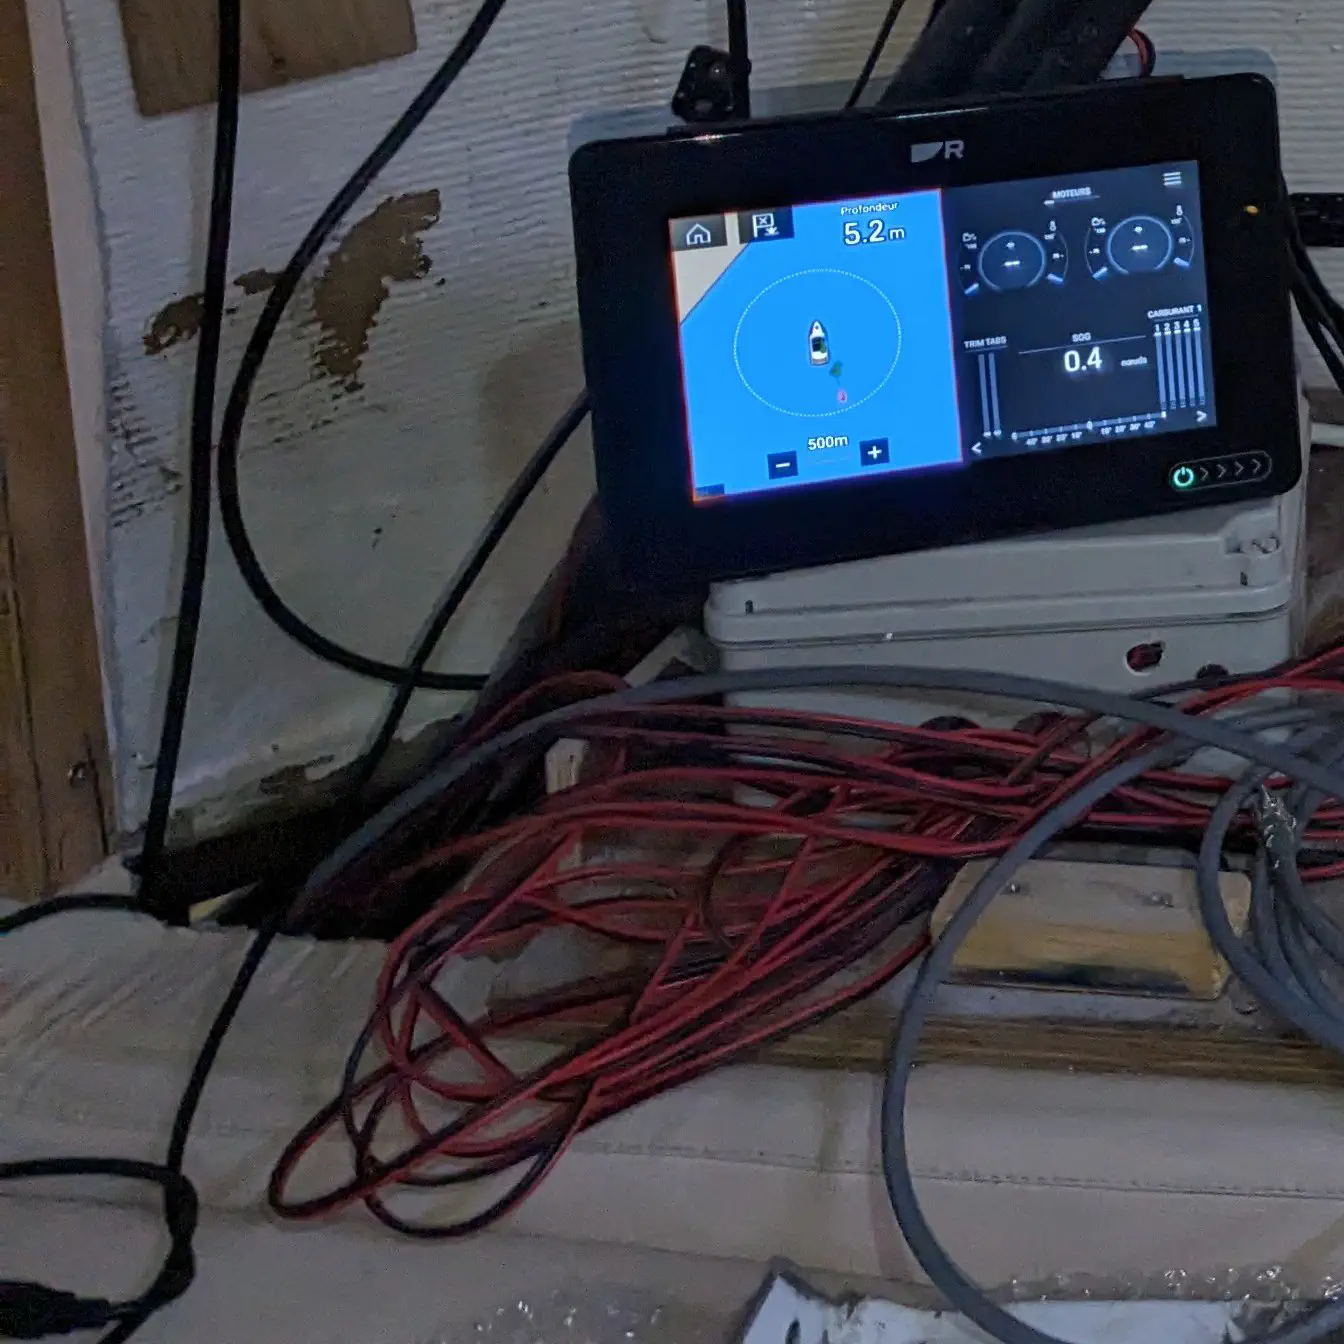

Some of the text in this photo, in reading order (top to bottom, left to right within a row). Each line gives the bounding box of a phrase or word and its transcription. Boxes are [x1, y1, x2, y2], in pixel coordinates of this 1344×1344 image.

[1052, 187, 1092, 199] MOTEURS
[840, 202, 899, 216] Profondeur
[844, 219, 905, 245] 5.2 m
[964, 336, 1007, 349] TRIM TABS
[1064, 346, 1103, 372] 0.4
[808, 434, 849, 451] 500m
